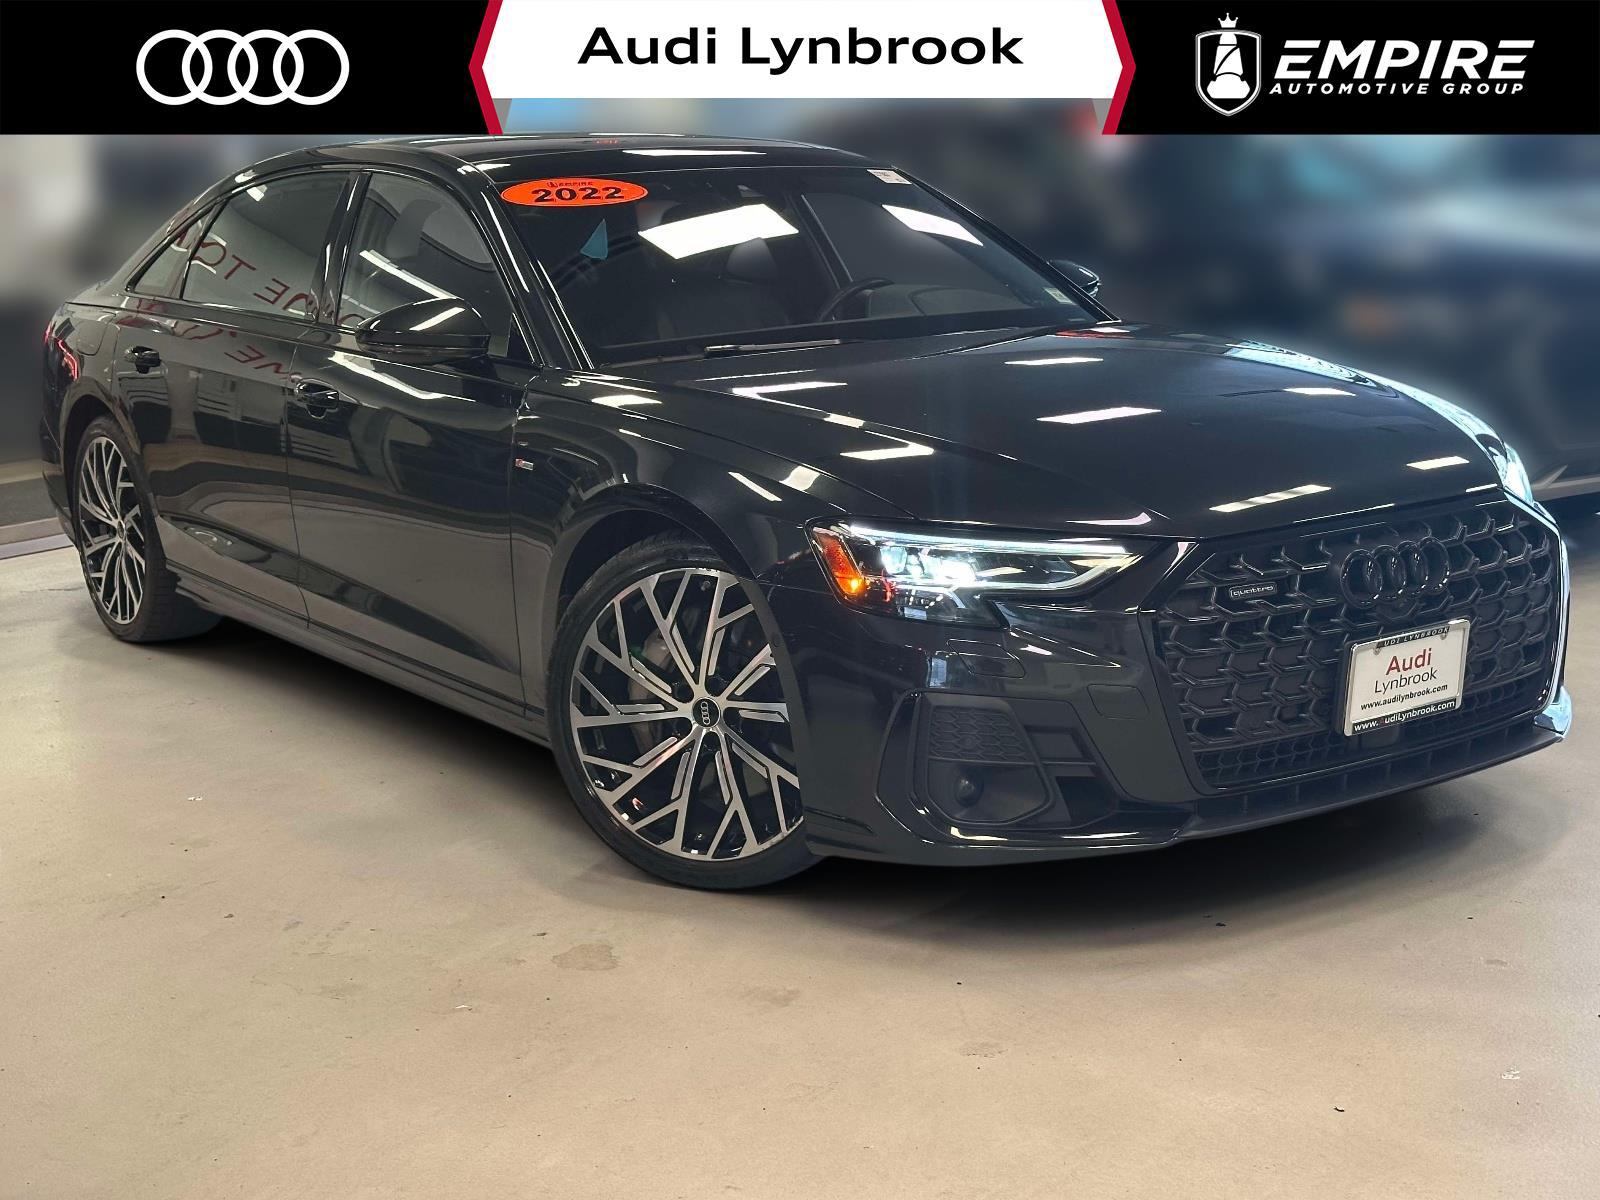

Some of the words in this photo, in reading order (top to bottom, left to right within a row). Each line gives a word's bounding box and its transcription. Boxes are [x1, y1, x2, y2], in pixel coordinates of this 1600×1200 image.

[531, 186, 625, 203] 2022
[1233, 585, 1274, 597] quattro
[1404, 627, 1450, 644] LYNBROOK
[1386, 647, 1432, 675] Audi
[1374, 667, 1438, 695] Lynbrook
[1360, 684, 1448, 710] www.audilynbrook.com
